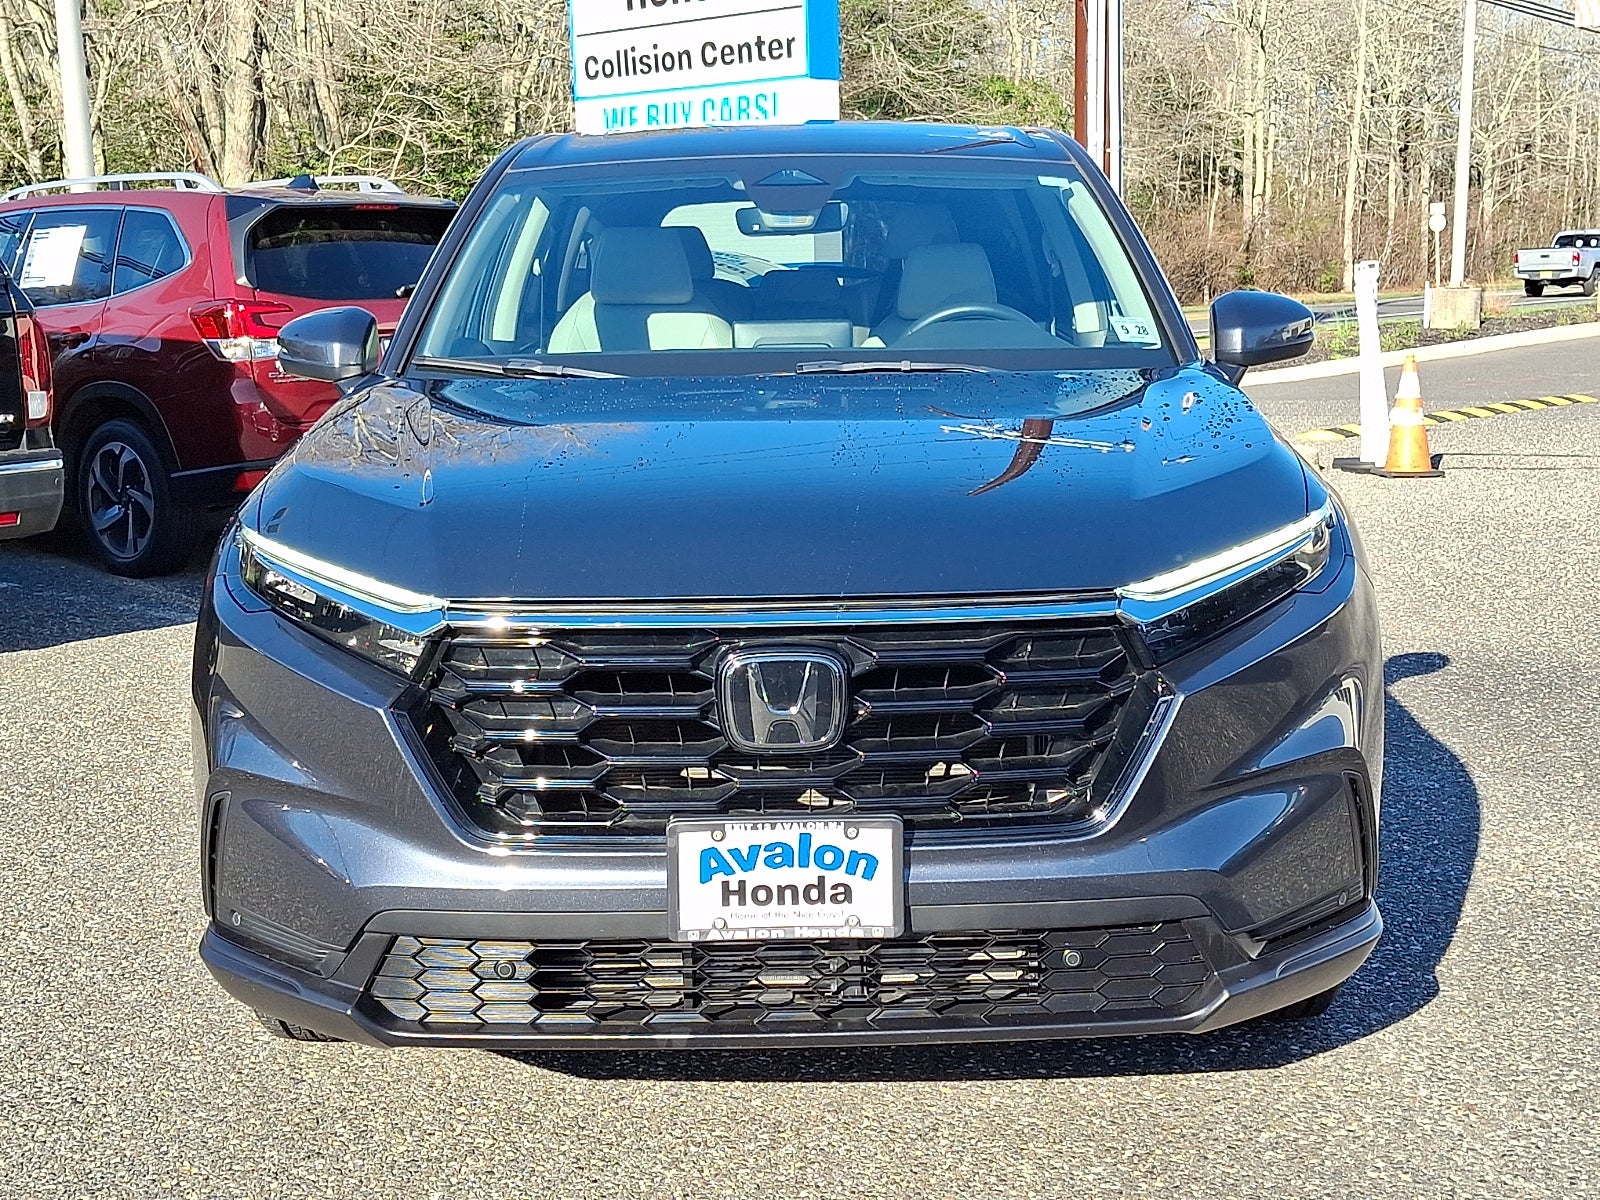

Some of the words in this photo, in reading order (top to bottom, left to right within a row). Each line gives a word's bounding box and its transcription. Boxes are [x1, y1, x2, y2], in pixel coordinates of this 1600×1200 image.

[584, 43, 693, 81] Collision
[701, 35, 796, 68] Center
[603, 105, 638, 130] WE
[647, 101, 692, 126] BUY
[1134, 325, 1150, 336] 28
[699, 832, 879, 884] Avalon
[721, 875, 853, 907] Honda
[706, 927, 785, 941] Avalon
[794, 926, 865, 939] Honda
